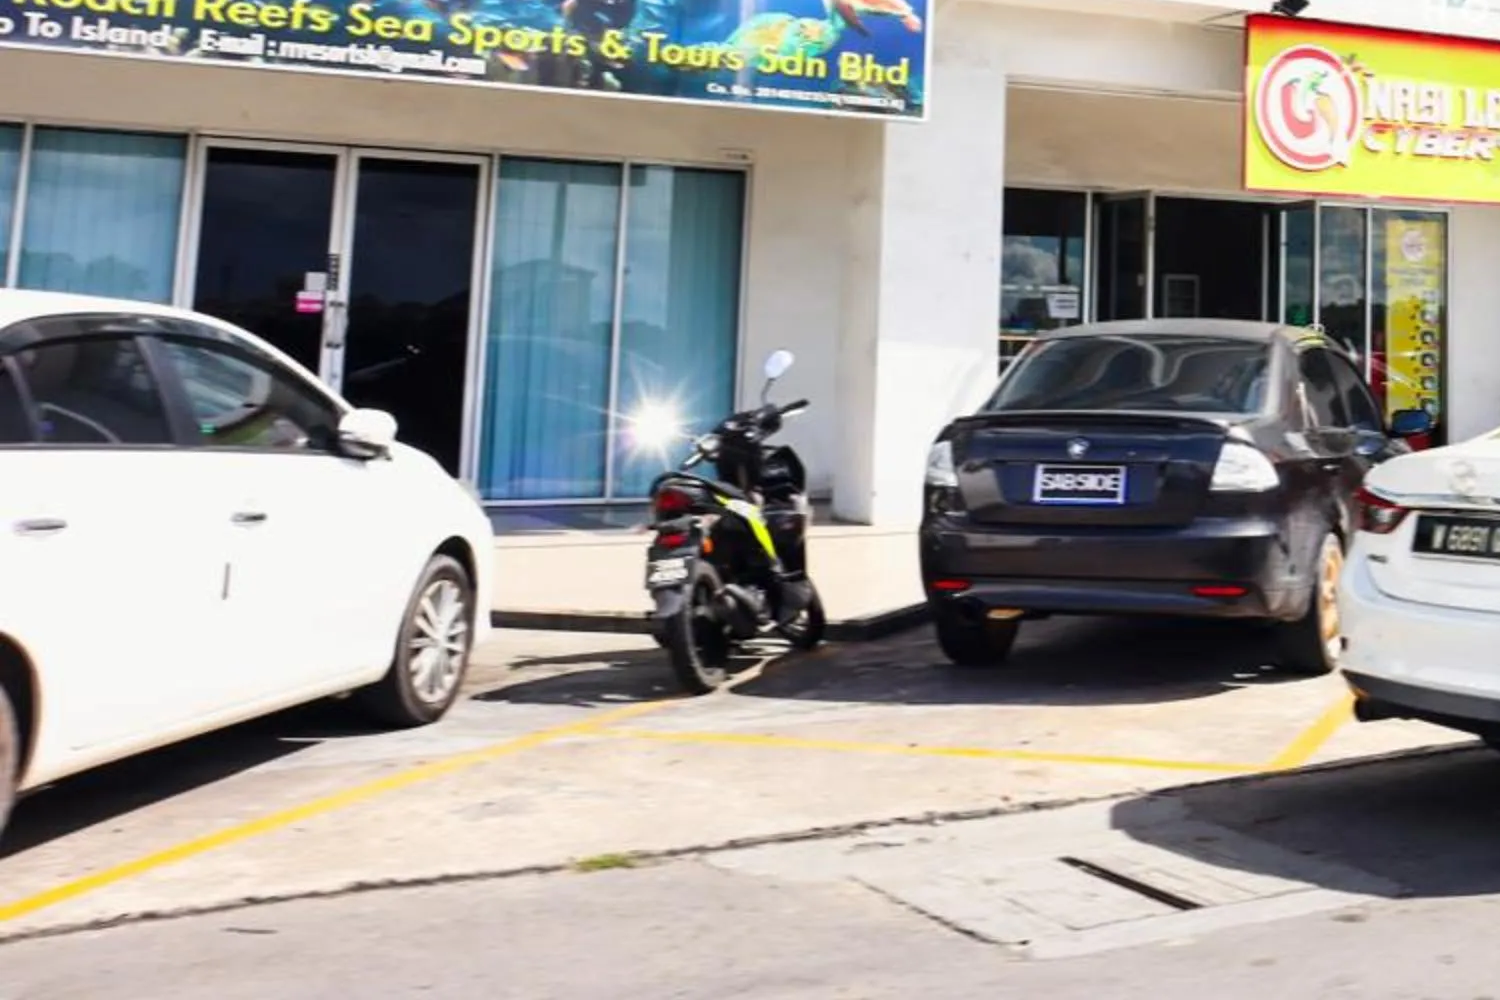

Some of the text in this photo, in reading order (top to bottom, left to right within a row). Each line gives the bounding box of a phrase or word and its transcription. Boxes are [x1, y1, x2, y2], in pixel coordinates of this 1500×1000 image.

[23, 10, 63, 39] To
[345, 3, 432, 43] Sea
[450, 11, 587, 58] Sports
[600, 30, 631, 61] &
[642, 32, 745, 72] Tours
[758, 44, 828, 79] Sdn
[839, 53, 910, 86] Bhd
